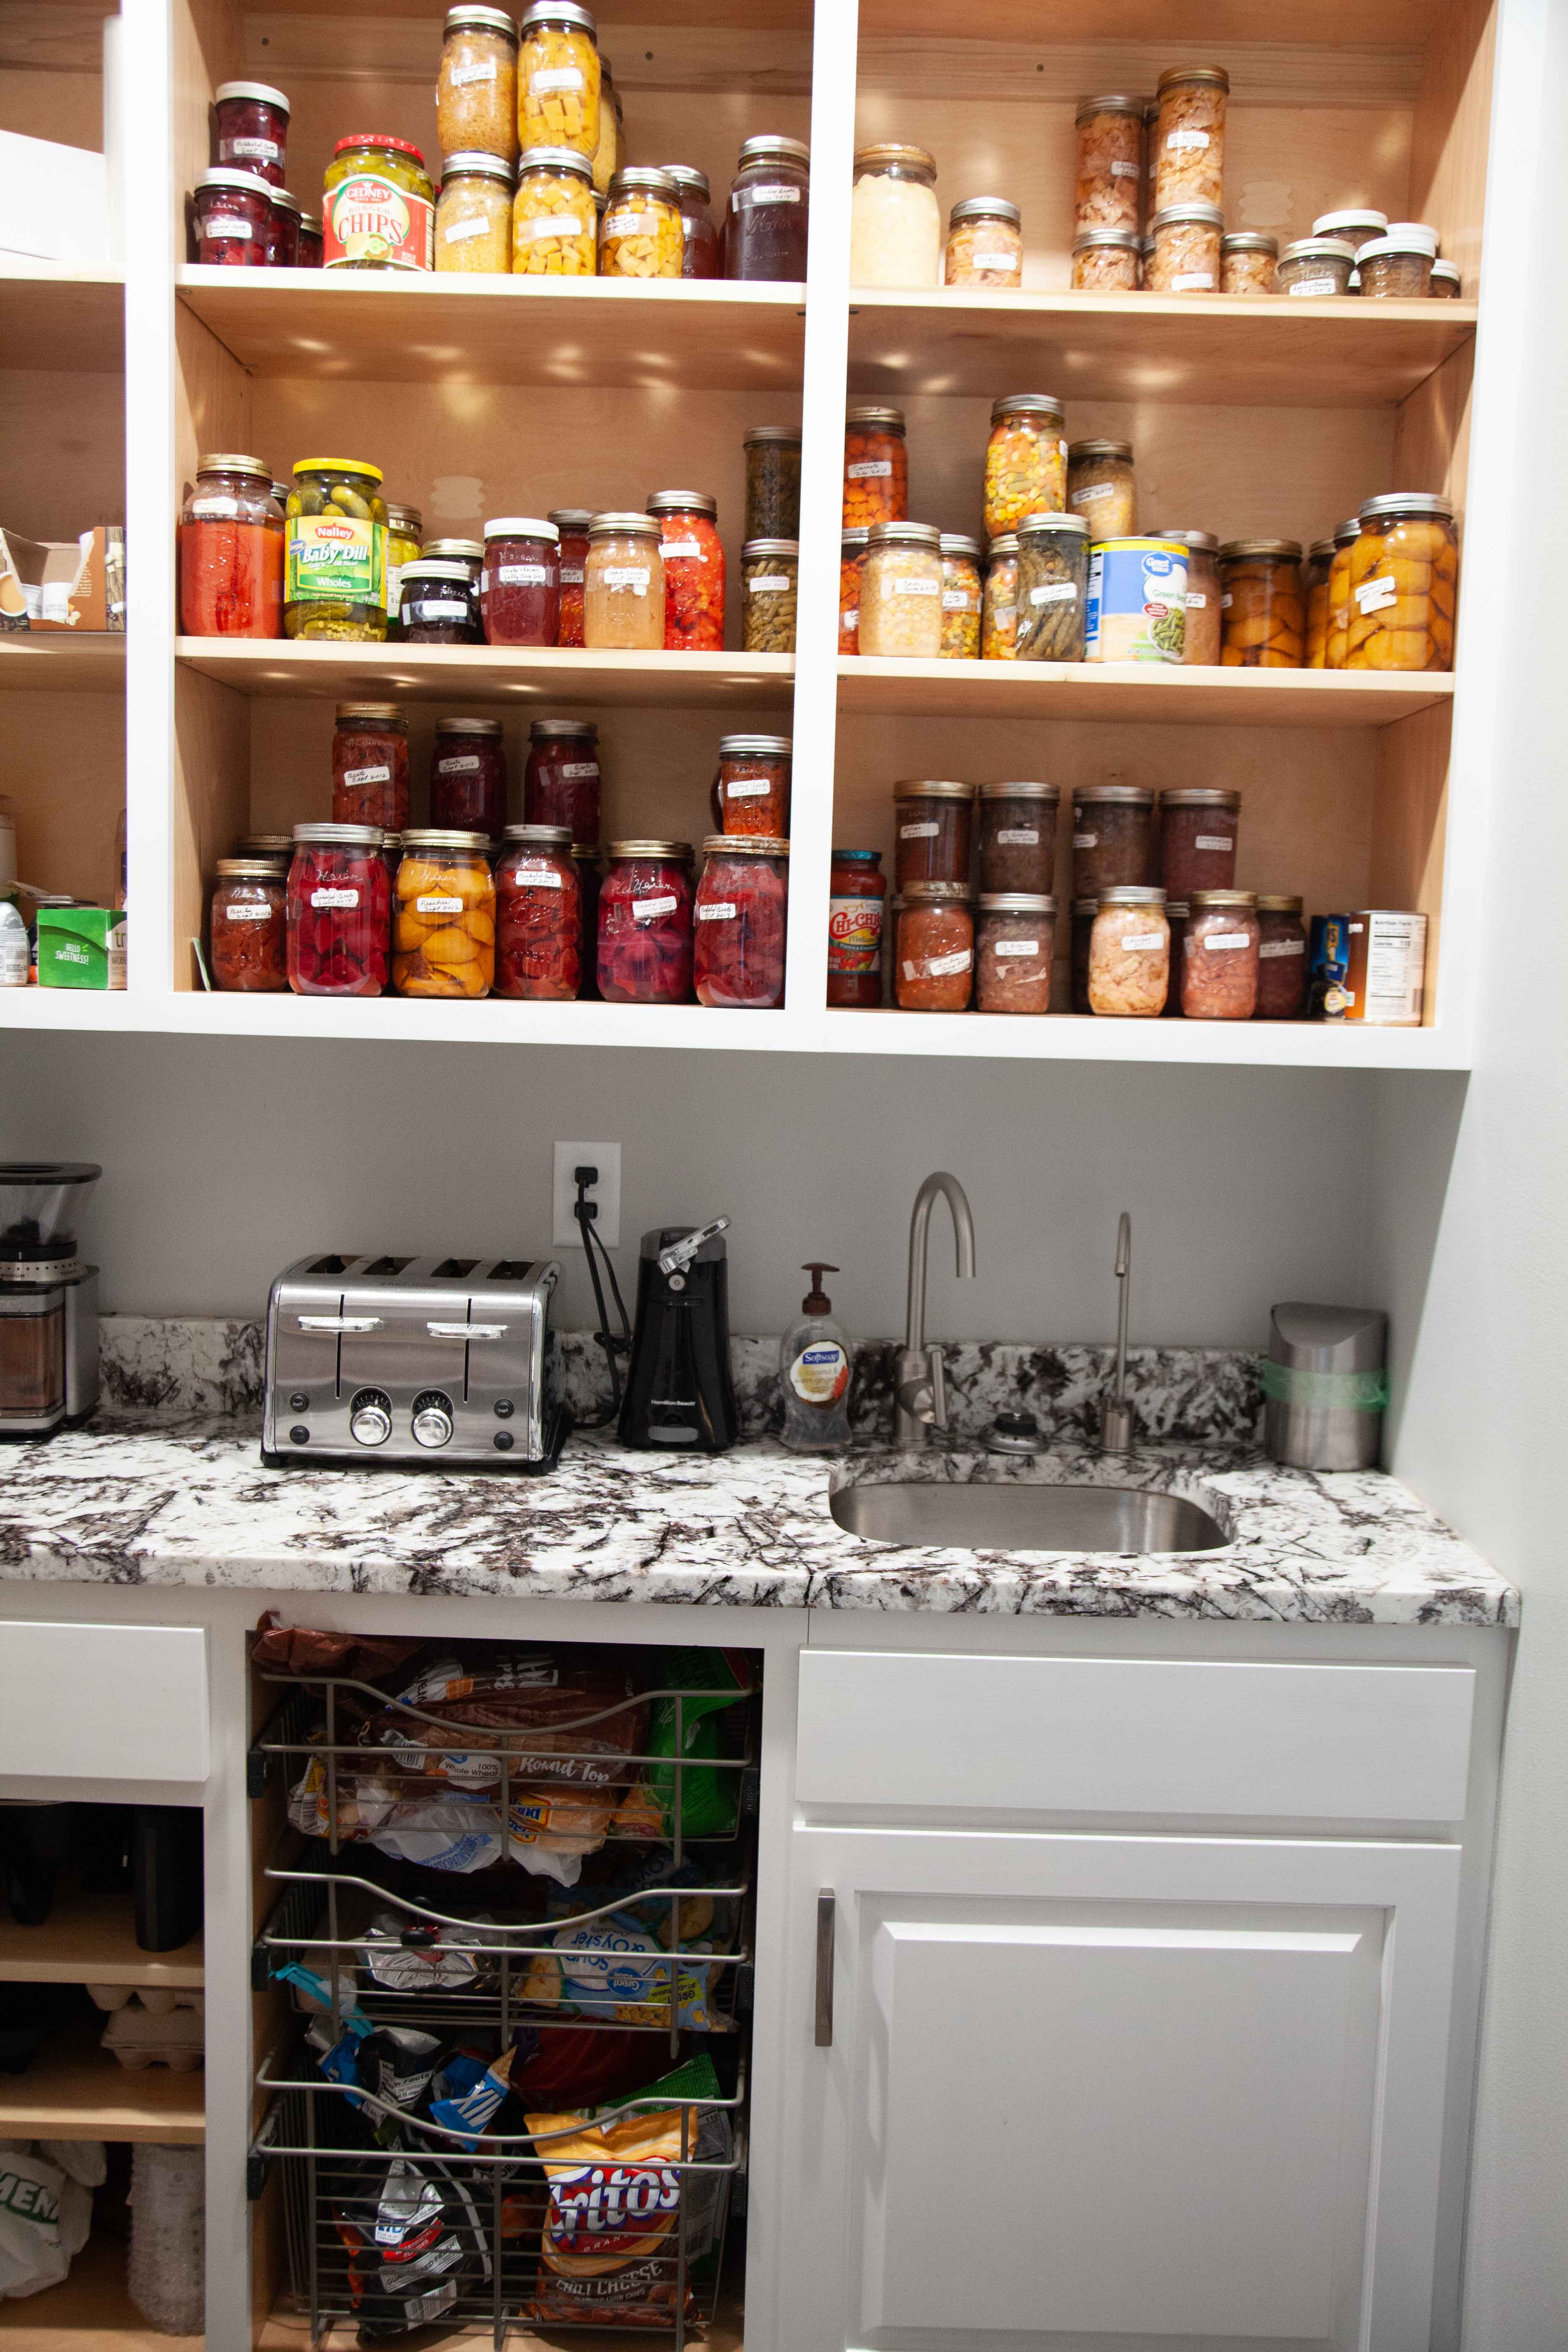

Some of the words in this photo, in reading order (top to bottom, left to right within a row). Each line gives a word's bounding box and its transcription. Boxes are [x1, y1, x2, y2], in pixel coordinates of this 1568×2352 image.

[347, 188, 393, 200] GEDNEY
[338, 213, 403, 245] CHIPS
[317, 527, 352, 539] Nalley
[302, 545, 342, 565] Baby
[343, 545, 368, 561] Dill
[317, 578, 352, 588] Wholes
[65, 943, 81, 953] HELLO
[55, 950, 89, 965] SWEETNESS!
[805, 1352, 838, 1363] Softsoap
[445, 1762, 469, 1774] Whole
[519, 1756, 577, 1778] Round
[571, 1931, 630, 1953] Oyster
[612, 1981, 640, 1991] Great
[547, 2158, 681, 2240] Fritos
[584, 2233, 631, 2252] BRAN
[556, 2278, 591, 2297] CHILI
[598, 2262, 663, 2297] CHEESE
